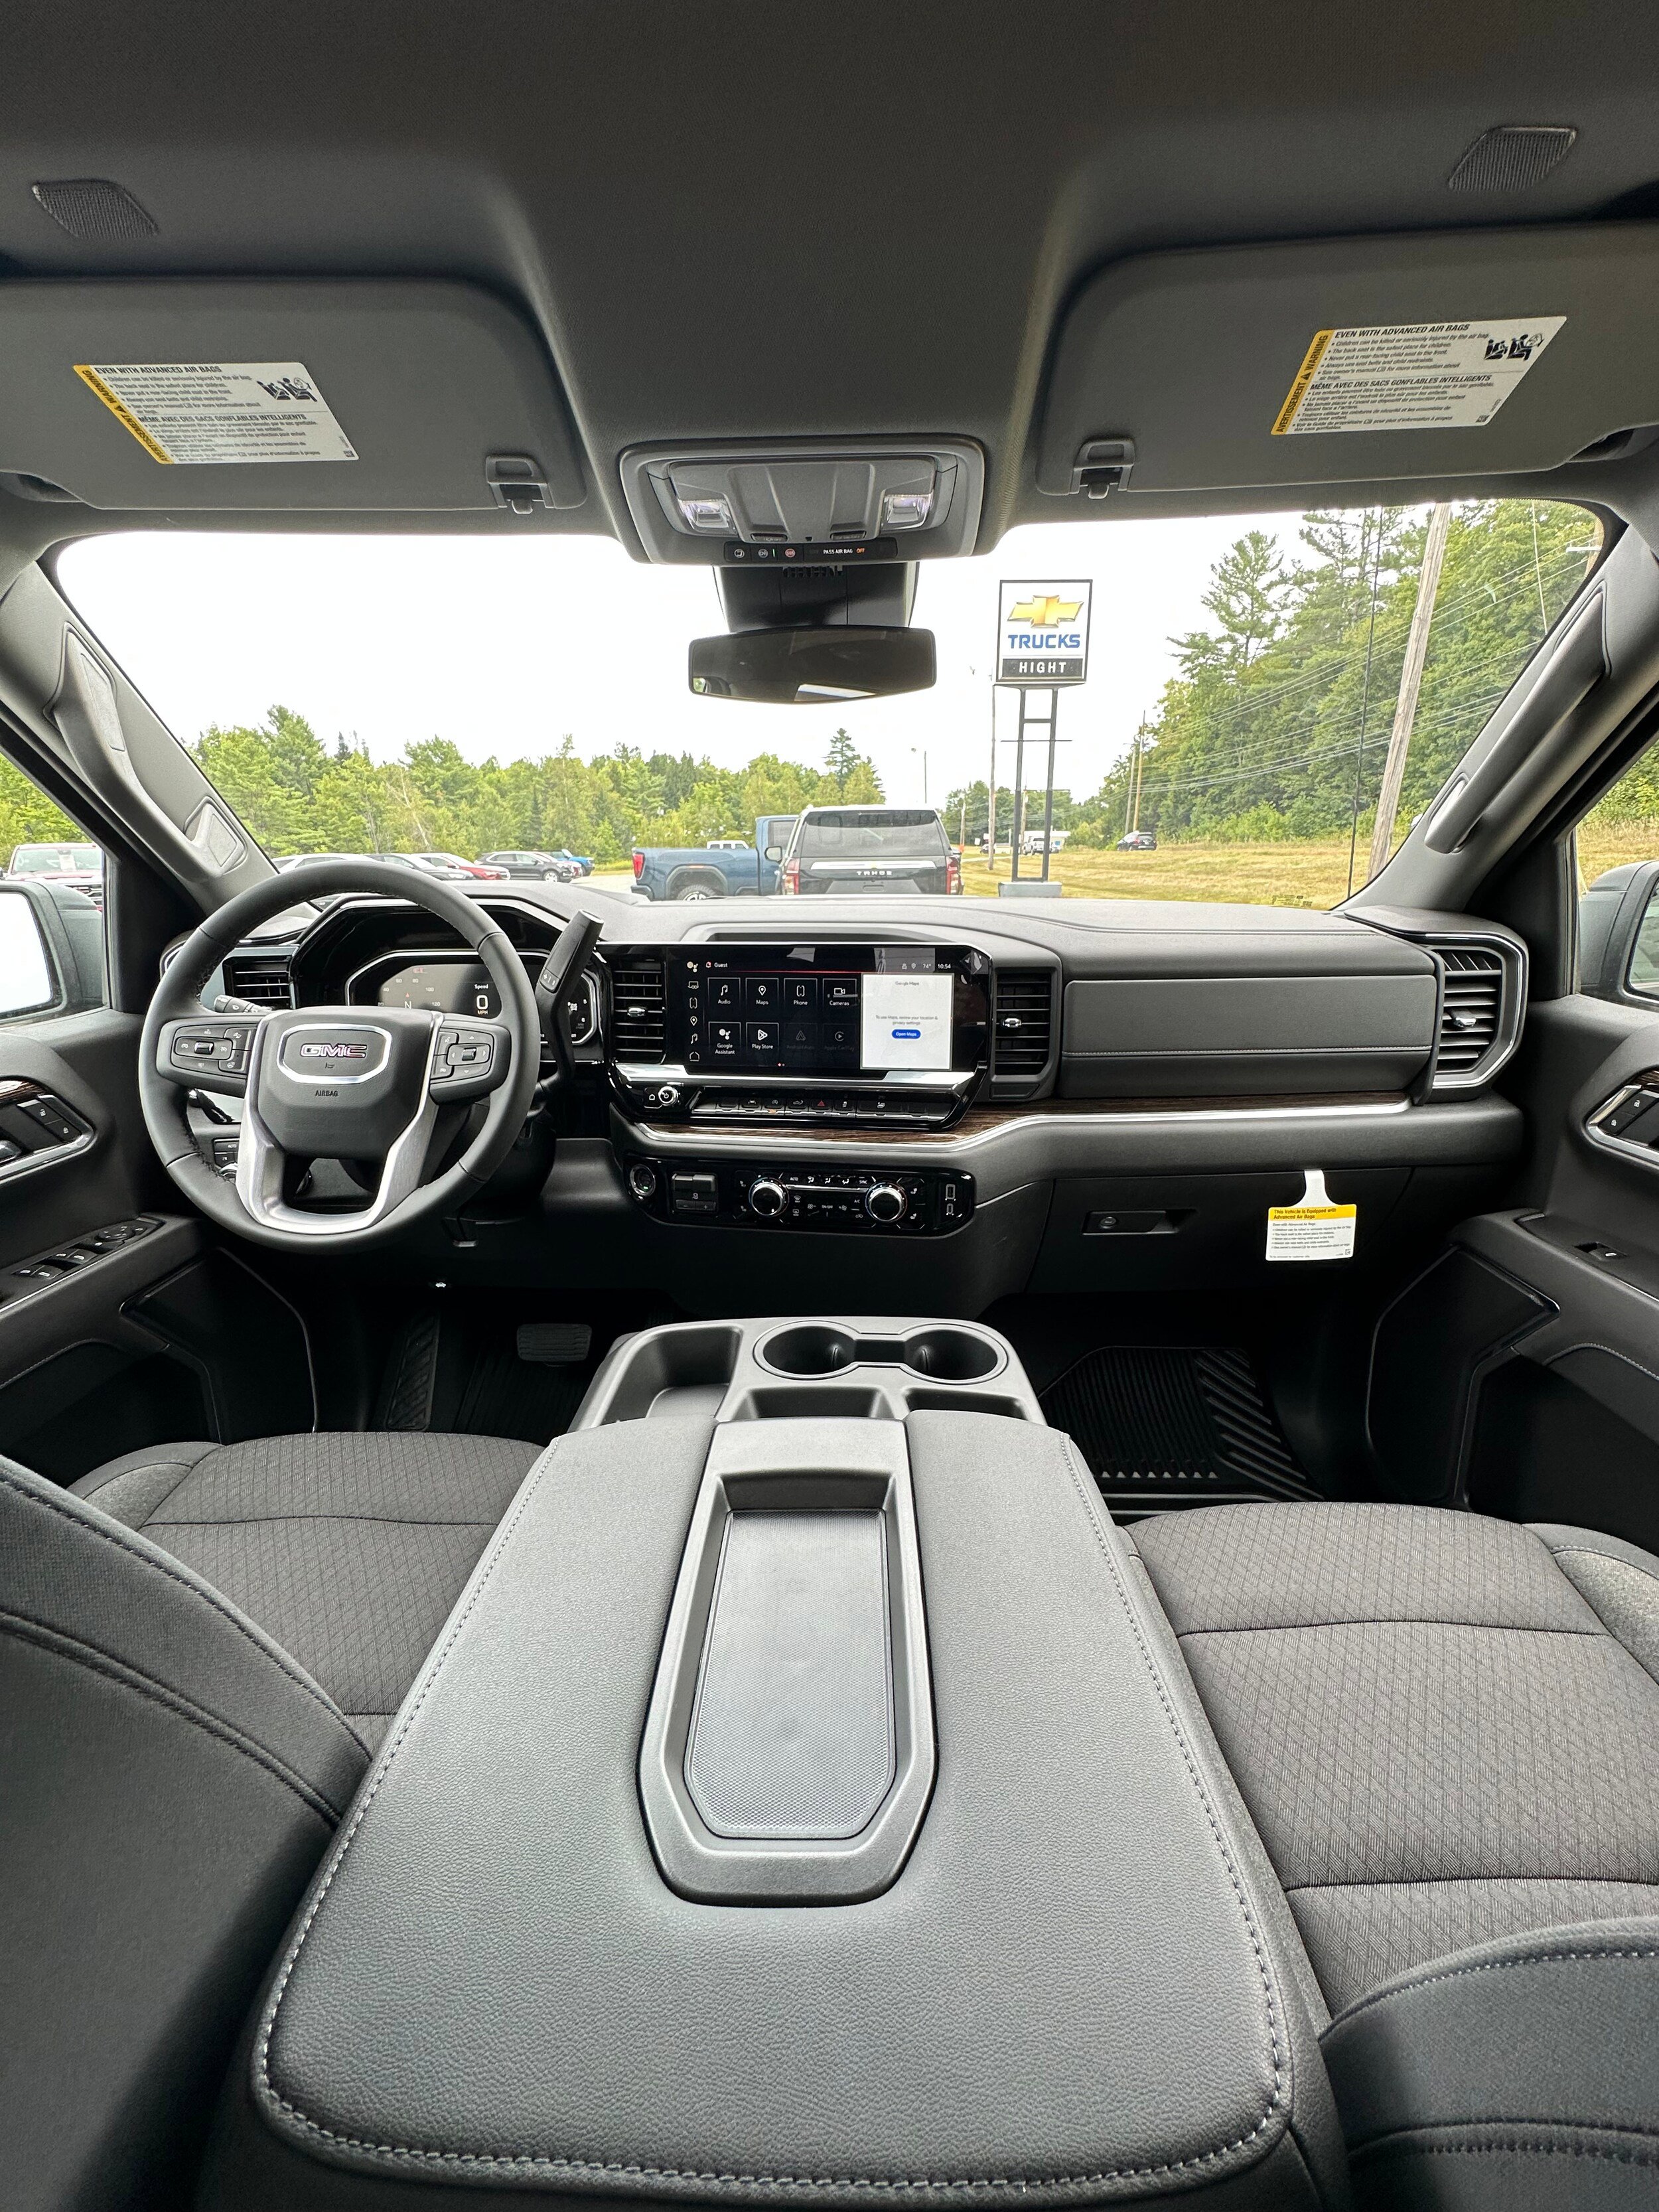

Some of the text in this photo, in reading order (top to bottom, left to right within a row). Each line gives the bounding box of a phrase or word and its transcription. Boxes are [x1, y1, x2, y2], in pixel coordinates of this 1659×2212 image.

[1380, 326, 1429, 335] ADVANCED
[1305, 334, 1328, 371] WARNING
[82, 370, 117, 404] WARNING
[1309, 380, 1334, 390] MÊME
[1389, 377, 1440, 386] GONFLABLES
[1437, 374, 1493, 384] INTELLIGENTS
[1276, 382, 1306, 433] AVERTISSEMENT
[120, 413, 170, 462] AVERTISSEMENT
[1008, 634, 1080, 648] TRUCKS
[1019, 661, 1066, 673] HIGHT
[404, 1001, 412, 1009] N
[476, 995, 488, 1010] 0
[300, 1043, 367, 1058] GMC
